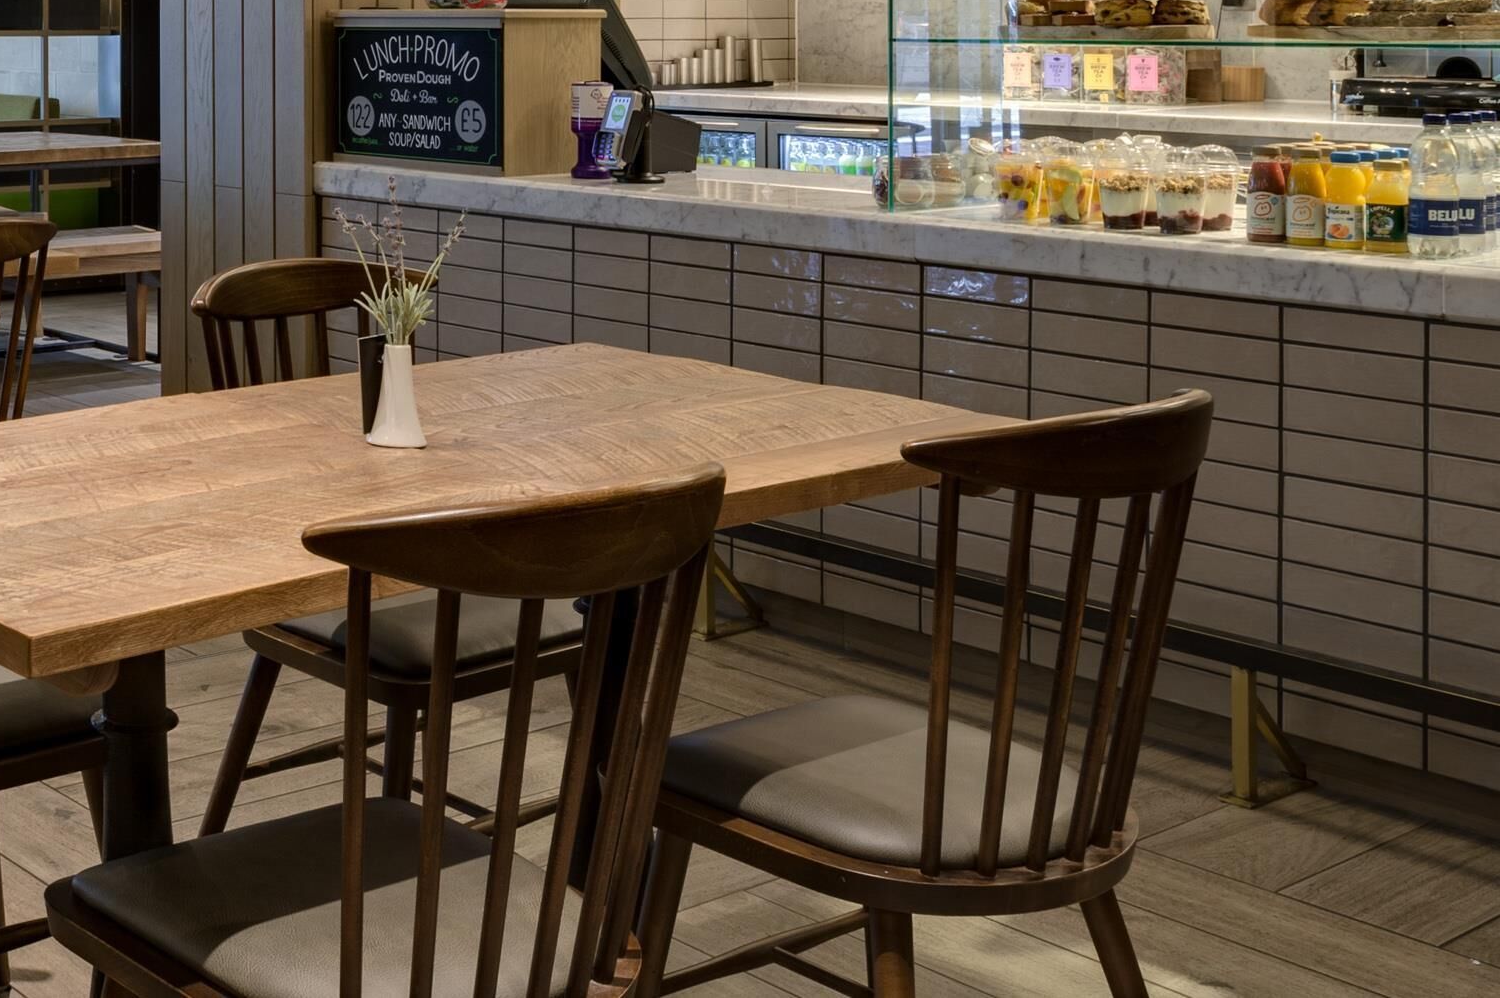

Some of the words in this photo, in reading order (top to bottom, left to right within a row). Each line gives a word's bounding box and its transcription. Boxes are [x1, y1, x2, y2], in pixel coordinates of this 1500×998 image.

[419, 89, 439, 104] Bar
[378, 112, 397, 129] ANY
[402, 114, 452, 132] SANDWICH
[460, 107, 482, 134] £5
